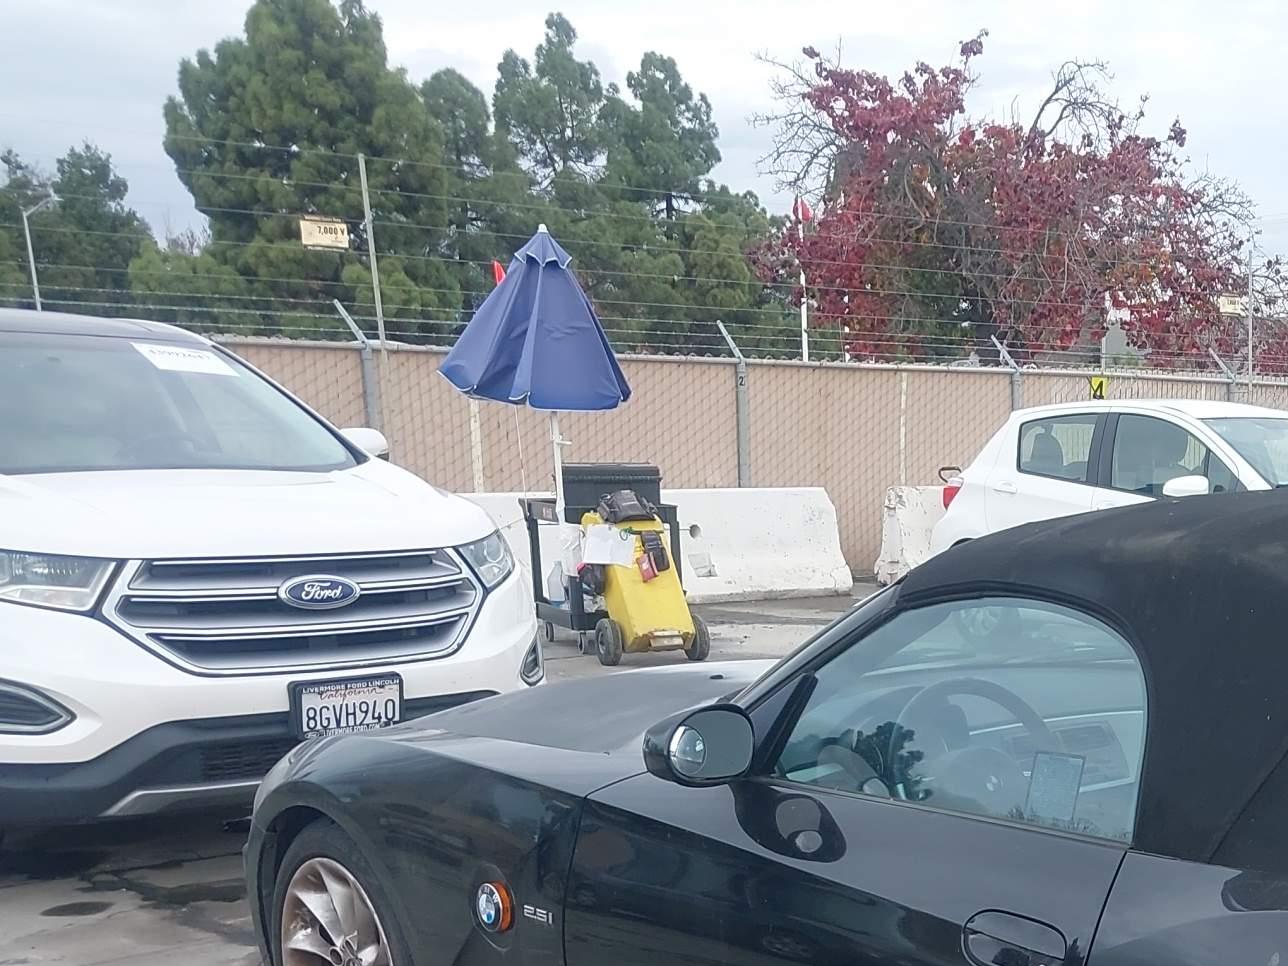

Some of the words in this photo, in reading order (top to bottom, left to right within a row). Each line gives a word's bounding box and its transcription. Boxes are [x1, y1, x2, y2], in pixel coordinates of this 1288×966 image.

[301, 581, 344, 600] Ford
[302, 685, 346, 693] LIVERMORE
[306, 698, 396, 730] 8GVH940
